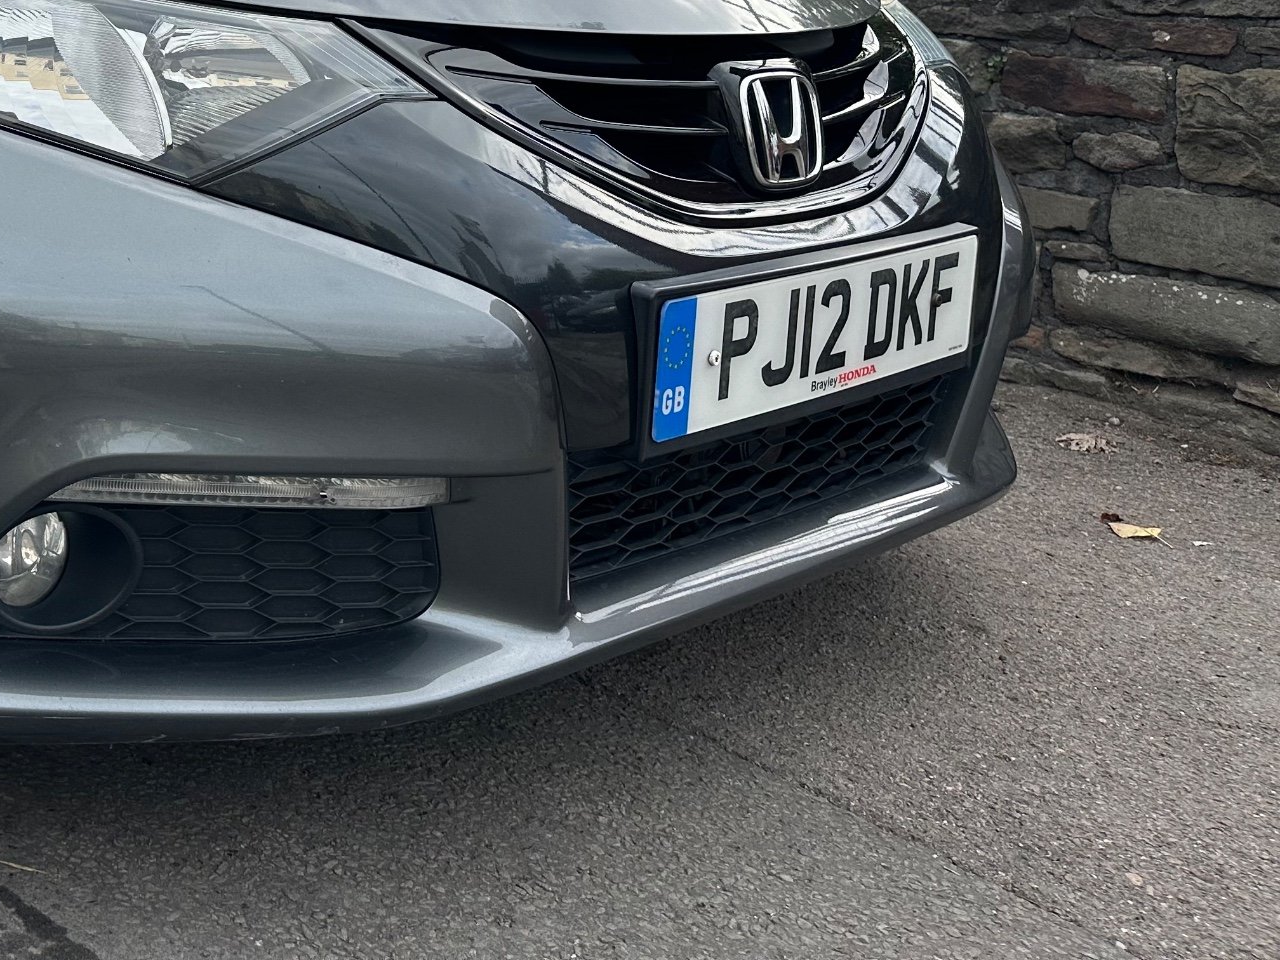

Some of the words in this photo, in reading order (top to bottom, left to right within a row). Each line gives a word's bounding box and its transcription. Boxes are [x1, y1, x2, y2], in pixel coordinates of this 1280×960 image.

[717, 278, 853, 402] PJ12
[863, 251, 960, 361] DKF
[811, 376, 838, 392] Brayley
[838, 364, 877, 384] HONDA
[661, 385, 685, 415] GB
